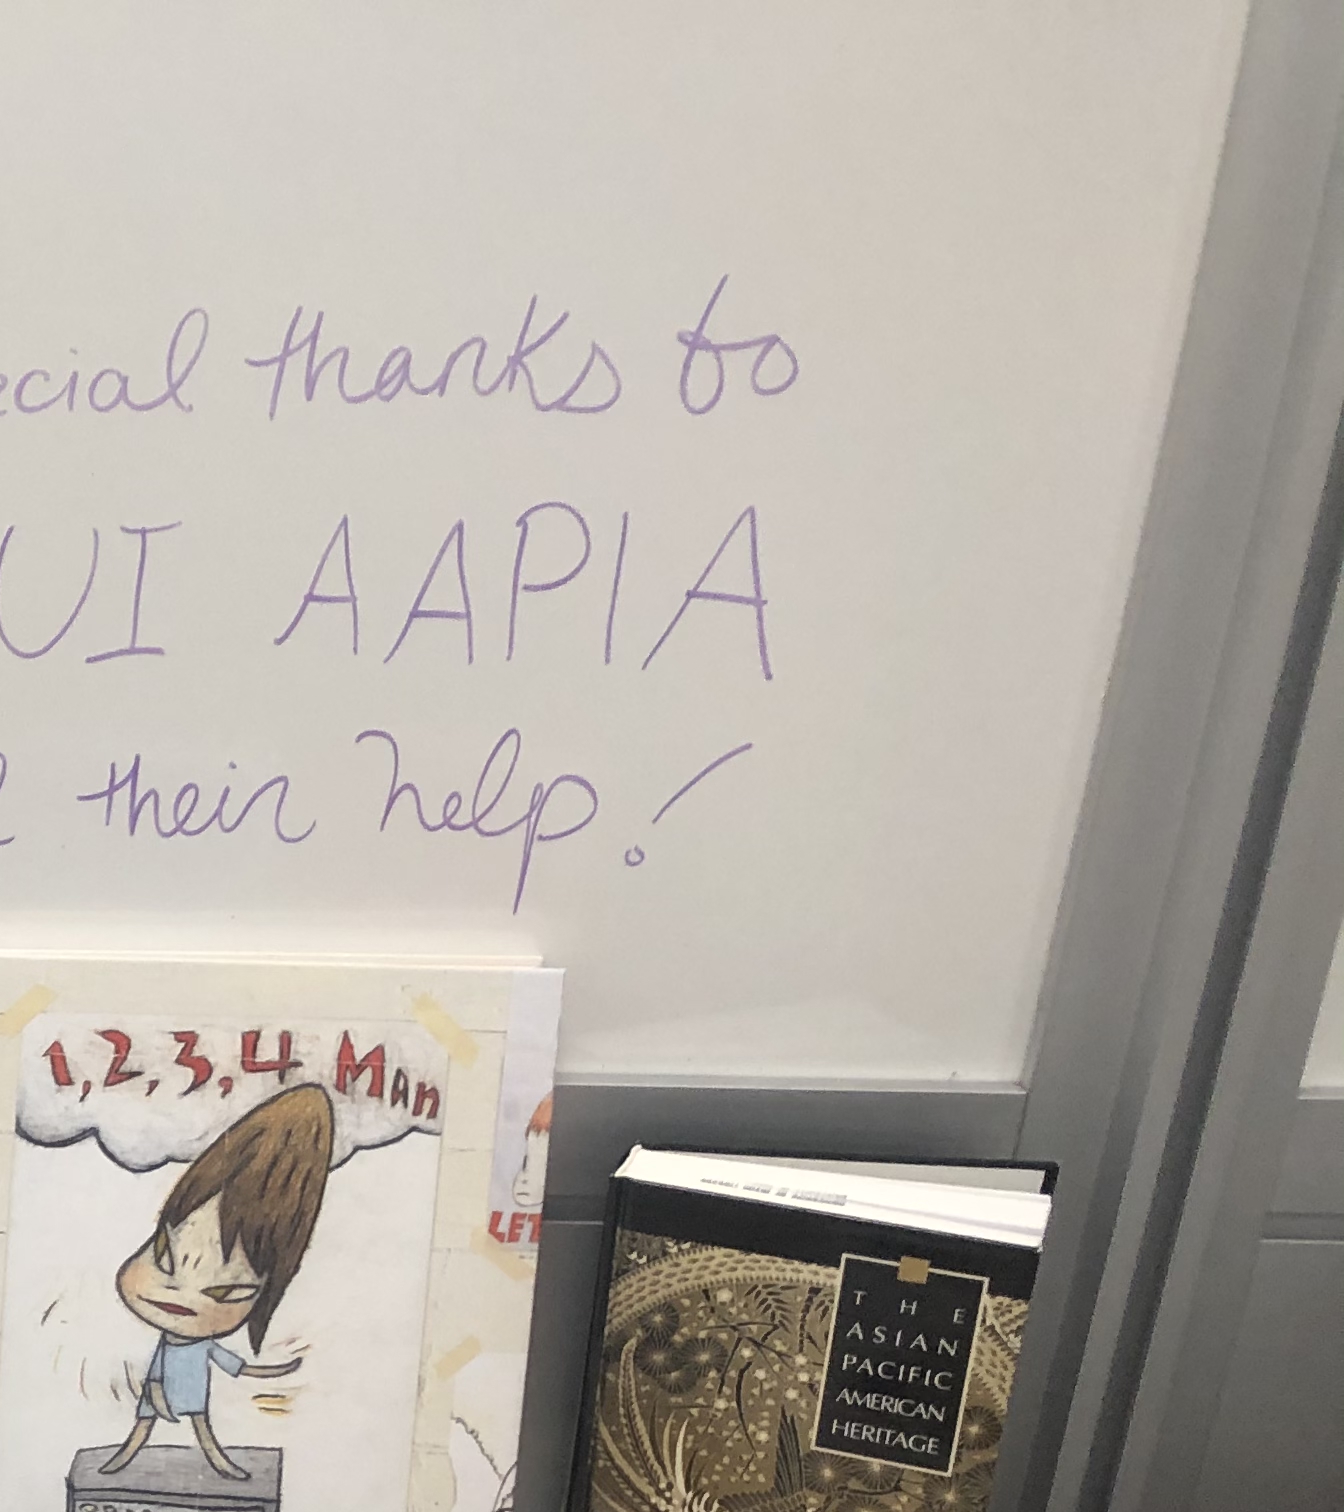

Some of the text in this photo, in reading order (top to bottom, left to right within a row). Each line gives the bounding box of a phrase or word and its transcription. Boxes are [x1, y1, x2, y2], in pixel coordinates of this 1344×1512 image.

[245, 294, 621, 420] thanks
[678, 273, 798, 413] to
[274, 502, 774, 682] AAPIA
[77, 753, 316, 843] their
[845, 1321, 959, 1357] ASIAN
[841, 1353, 953, 1392] PACIFIC
[835, 1387, 947, 1422] AMERICAN
[831, 1418, 940, 1456] HERITAGE
